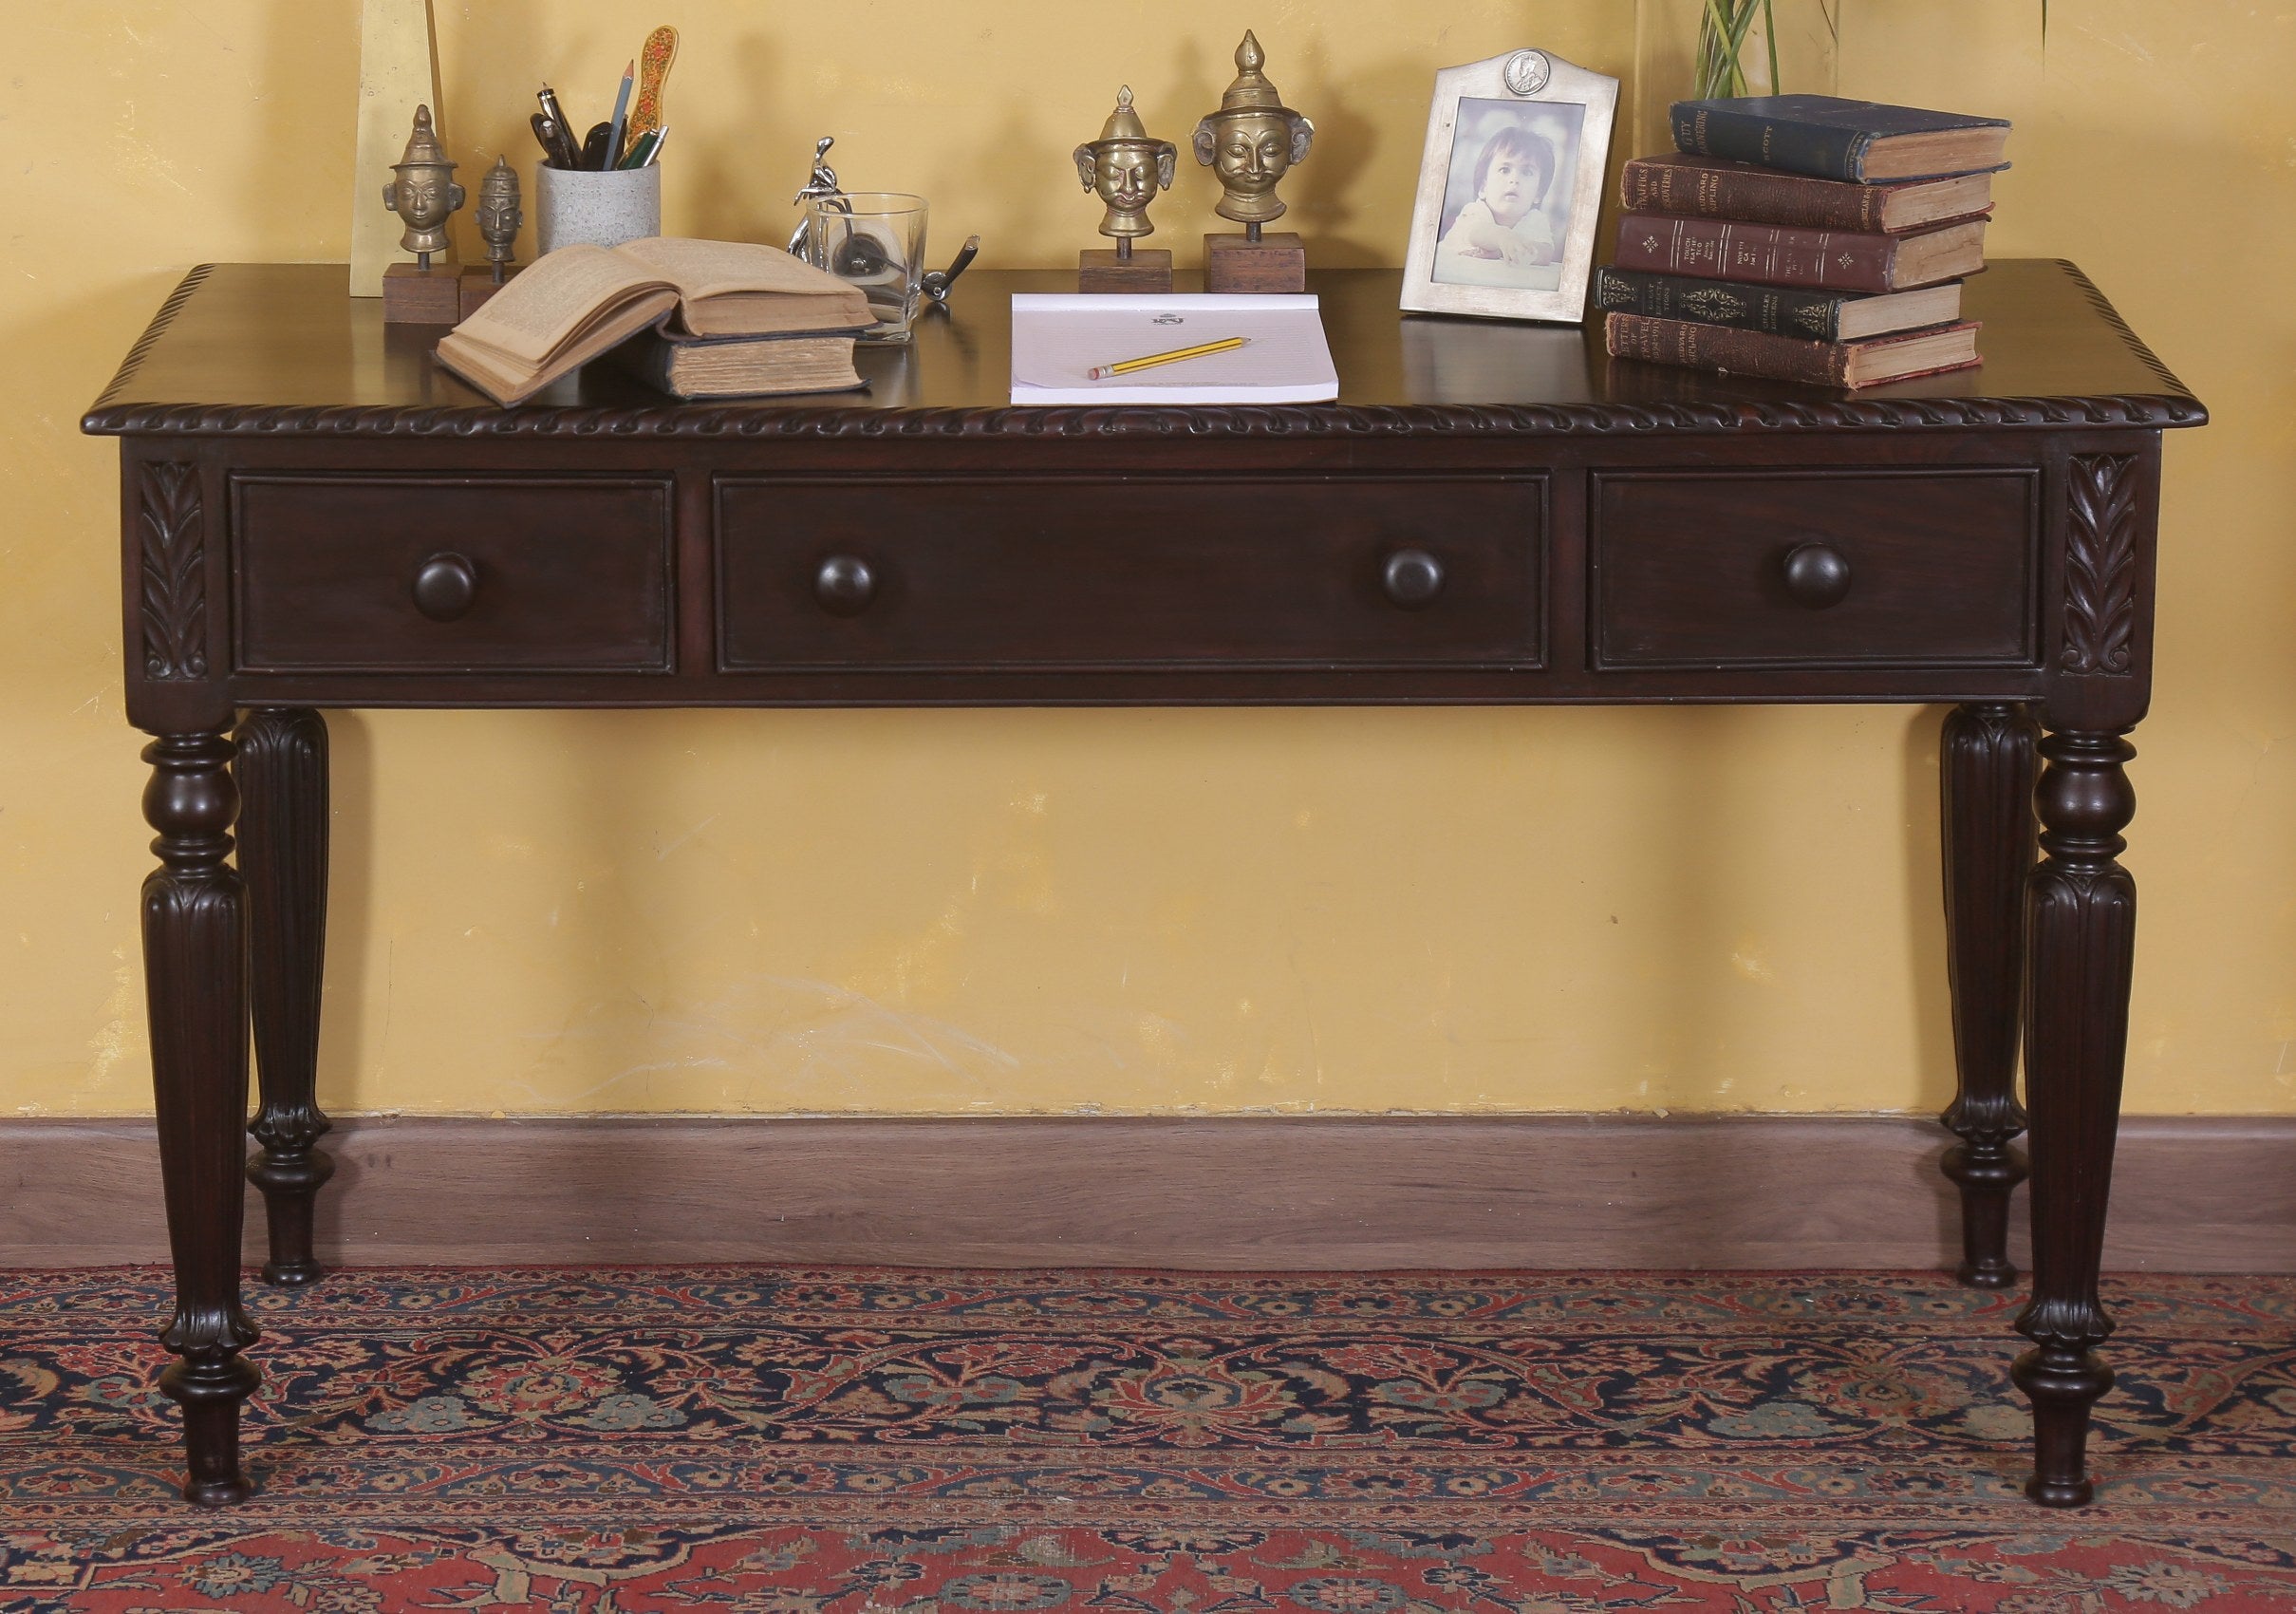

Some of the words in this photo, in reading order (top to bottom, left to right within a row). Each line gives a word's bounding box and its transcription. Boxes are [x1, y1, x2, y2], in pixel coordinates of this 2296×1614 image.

[1680, 121, 1693, 145] GUY
[1762, 125, 1774, 161] SCOTT
[1637, 168, 1649, 208] TRAFFICS
[1698, 173, 1709, 213] RUDYARD
[1631, 332, 1637, 345] OF
